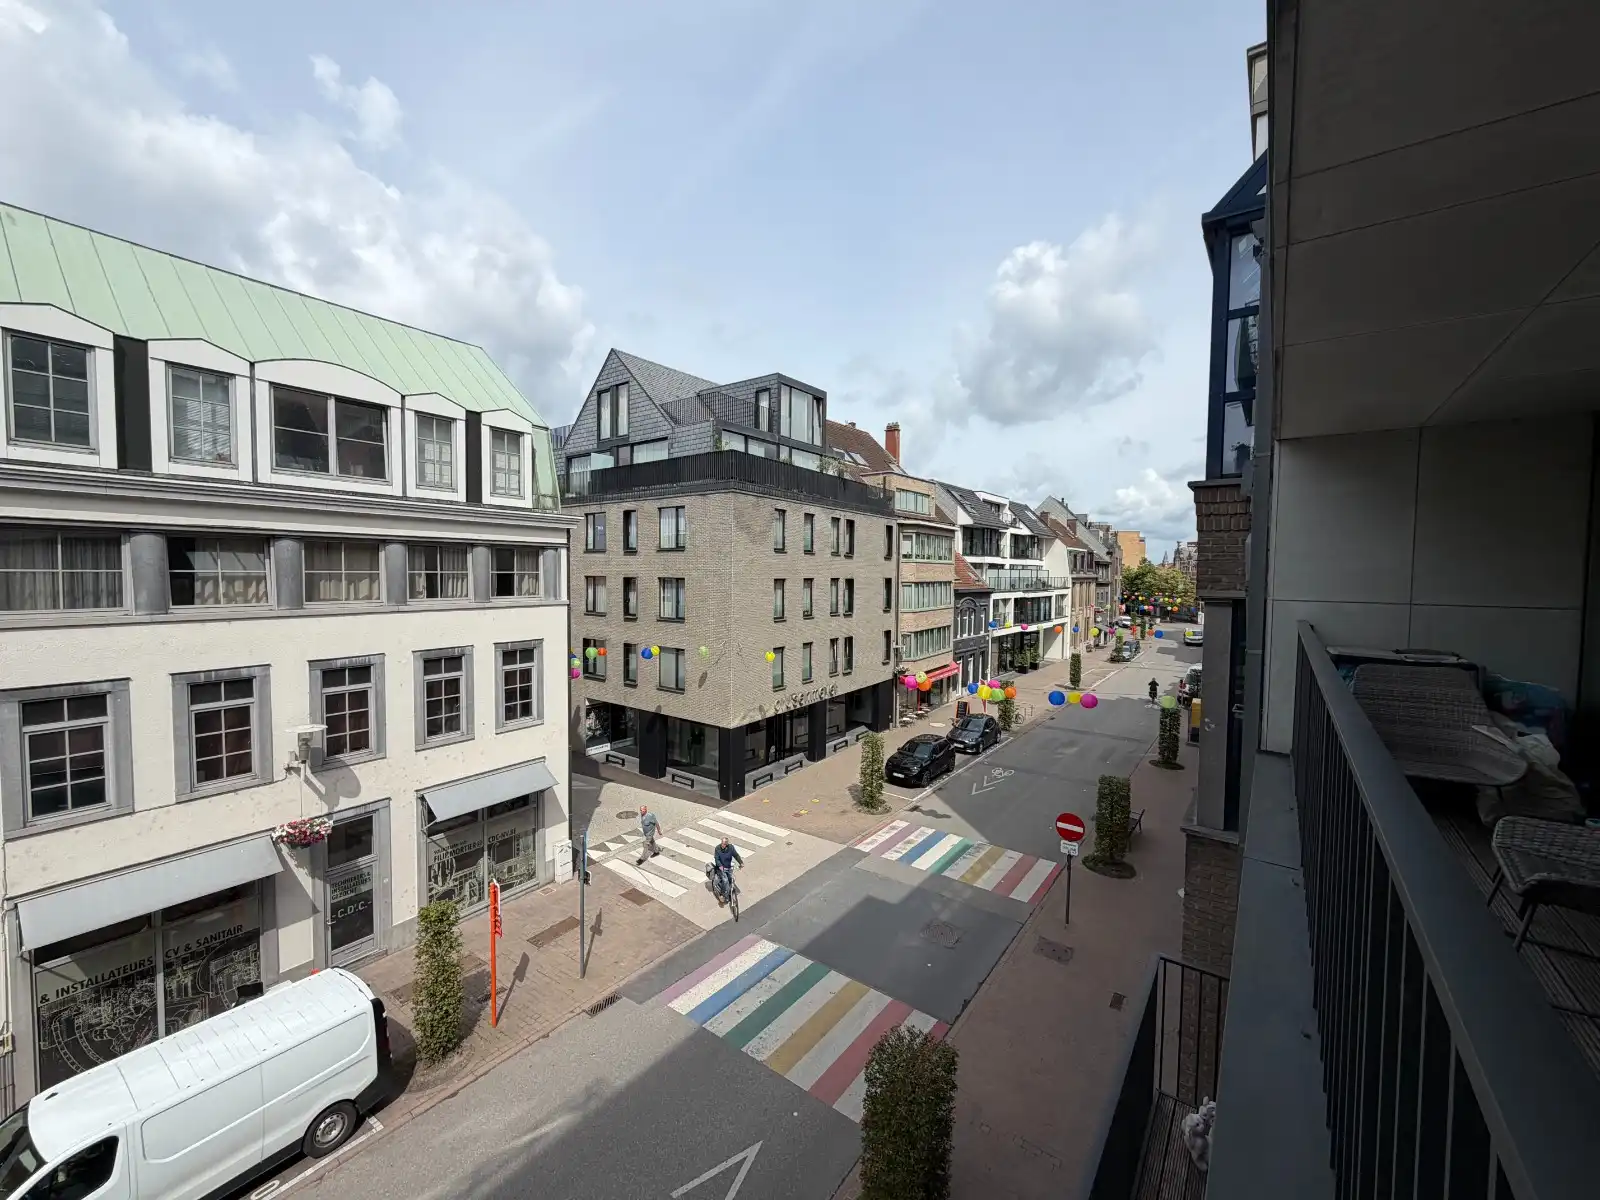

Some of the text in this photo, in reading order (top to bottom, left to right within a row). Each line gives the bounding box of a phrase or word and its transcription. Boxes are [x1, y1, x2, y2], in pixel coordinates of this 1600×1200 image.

[40, 924, 244, 1005] & INSTALLATEURS CV & SANITAIR
